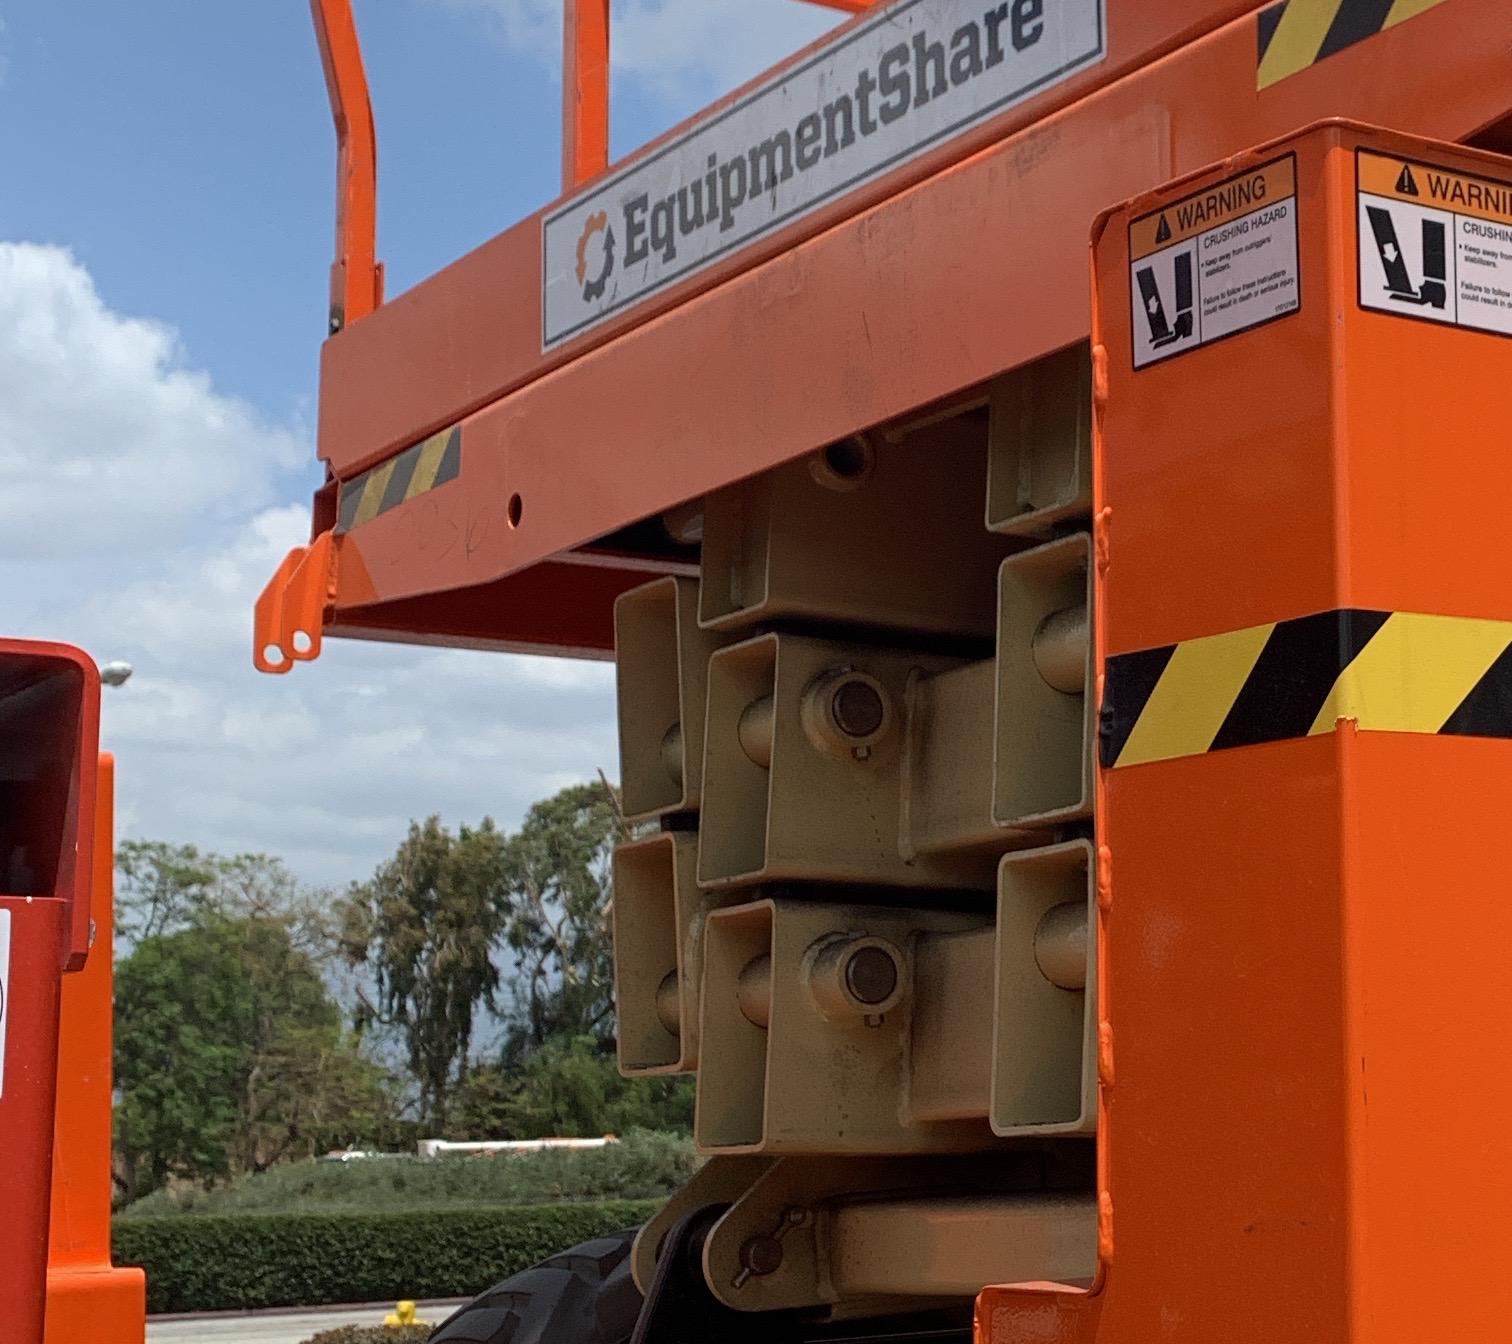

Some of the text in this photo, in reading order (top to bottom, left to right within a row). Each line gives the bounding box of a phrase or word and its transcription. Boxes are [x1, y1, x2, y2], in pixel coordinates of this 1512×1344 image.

[1176, 174, 1266, 232] WARNING
[1203, 205, 1287, 249] CRUSHING HAZARD
